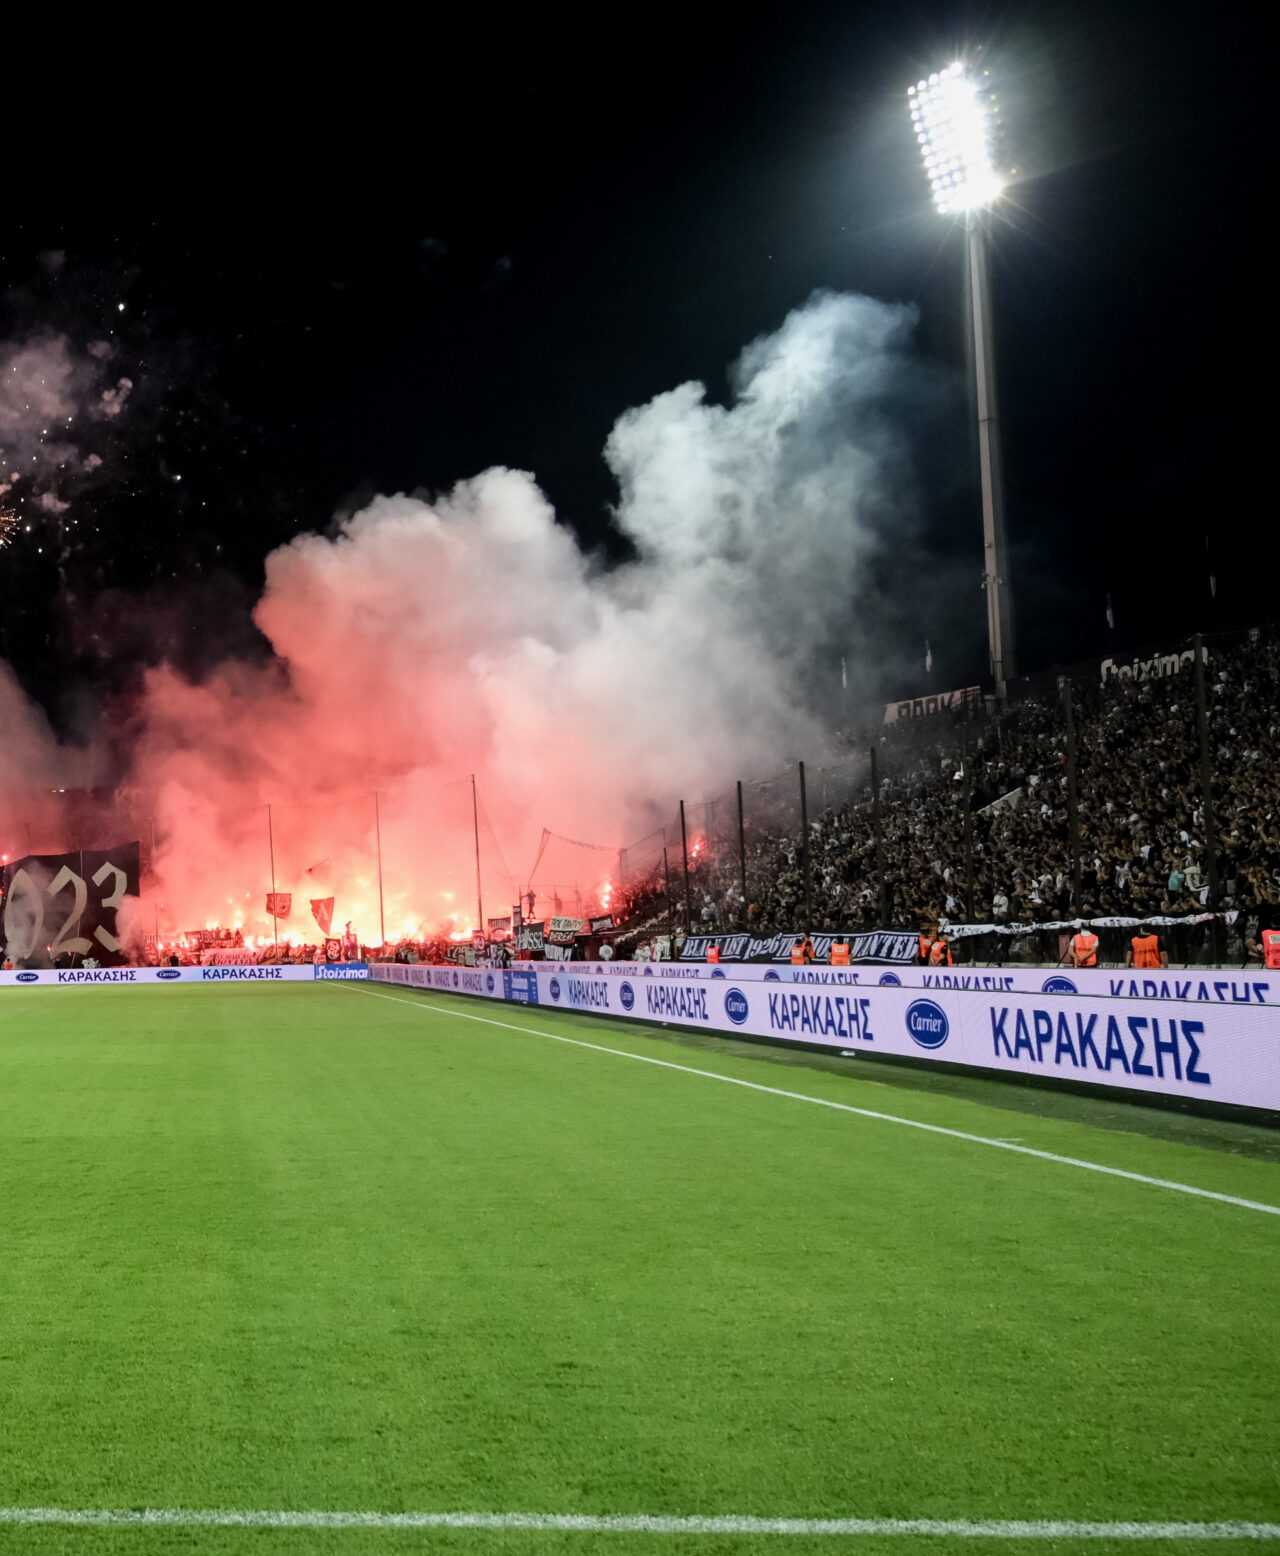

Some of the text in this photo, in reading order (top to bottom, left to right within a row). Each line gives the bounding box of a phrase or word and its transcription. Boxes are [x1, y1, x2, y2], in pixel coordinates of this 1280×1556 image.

[743, 933, 782, 960] 1926
[852, 934, 920, 959] WANTED
[58, 970, 136, 982] ΚΑΡΑΚΑΣΗΣ
[202, 968, 283, 979] ΚΑΡΑΚΑΣΗΣ
[568, 980, 609, 1008] ΚΑΡΑΚΑΣΗΣ
[646, 985, 709, 1020] ΚΑΡΑΚΑΣΗΣ
[768, 993, 873, 1040] ΚΑΡΑΚΑΣΗΣ
[910, 1011, 943, 1033] Carrier
[989, 1007, 1211, 1084] ΚΑΡΑΚΑΣΗΣ
